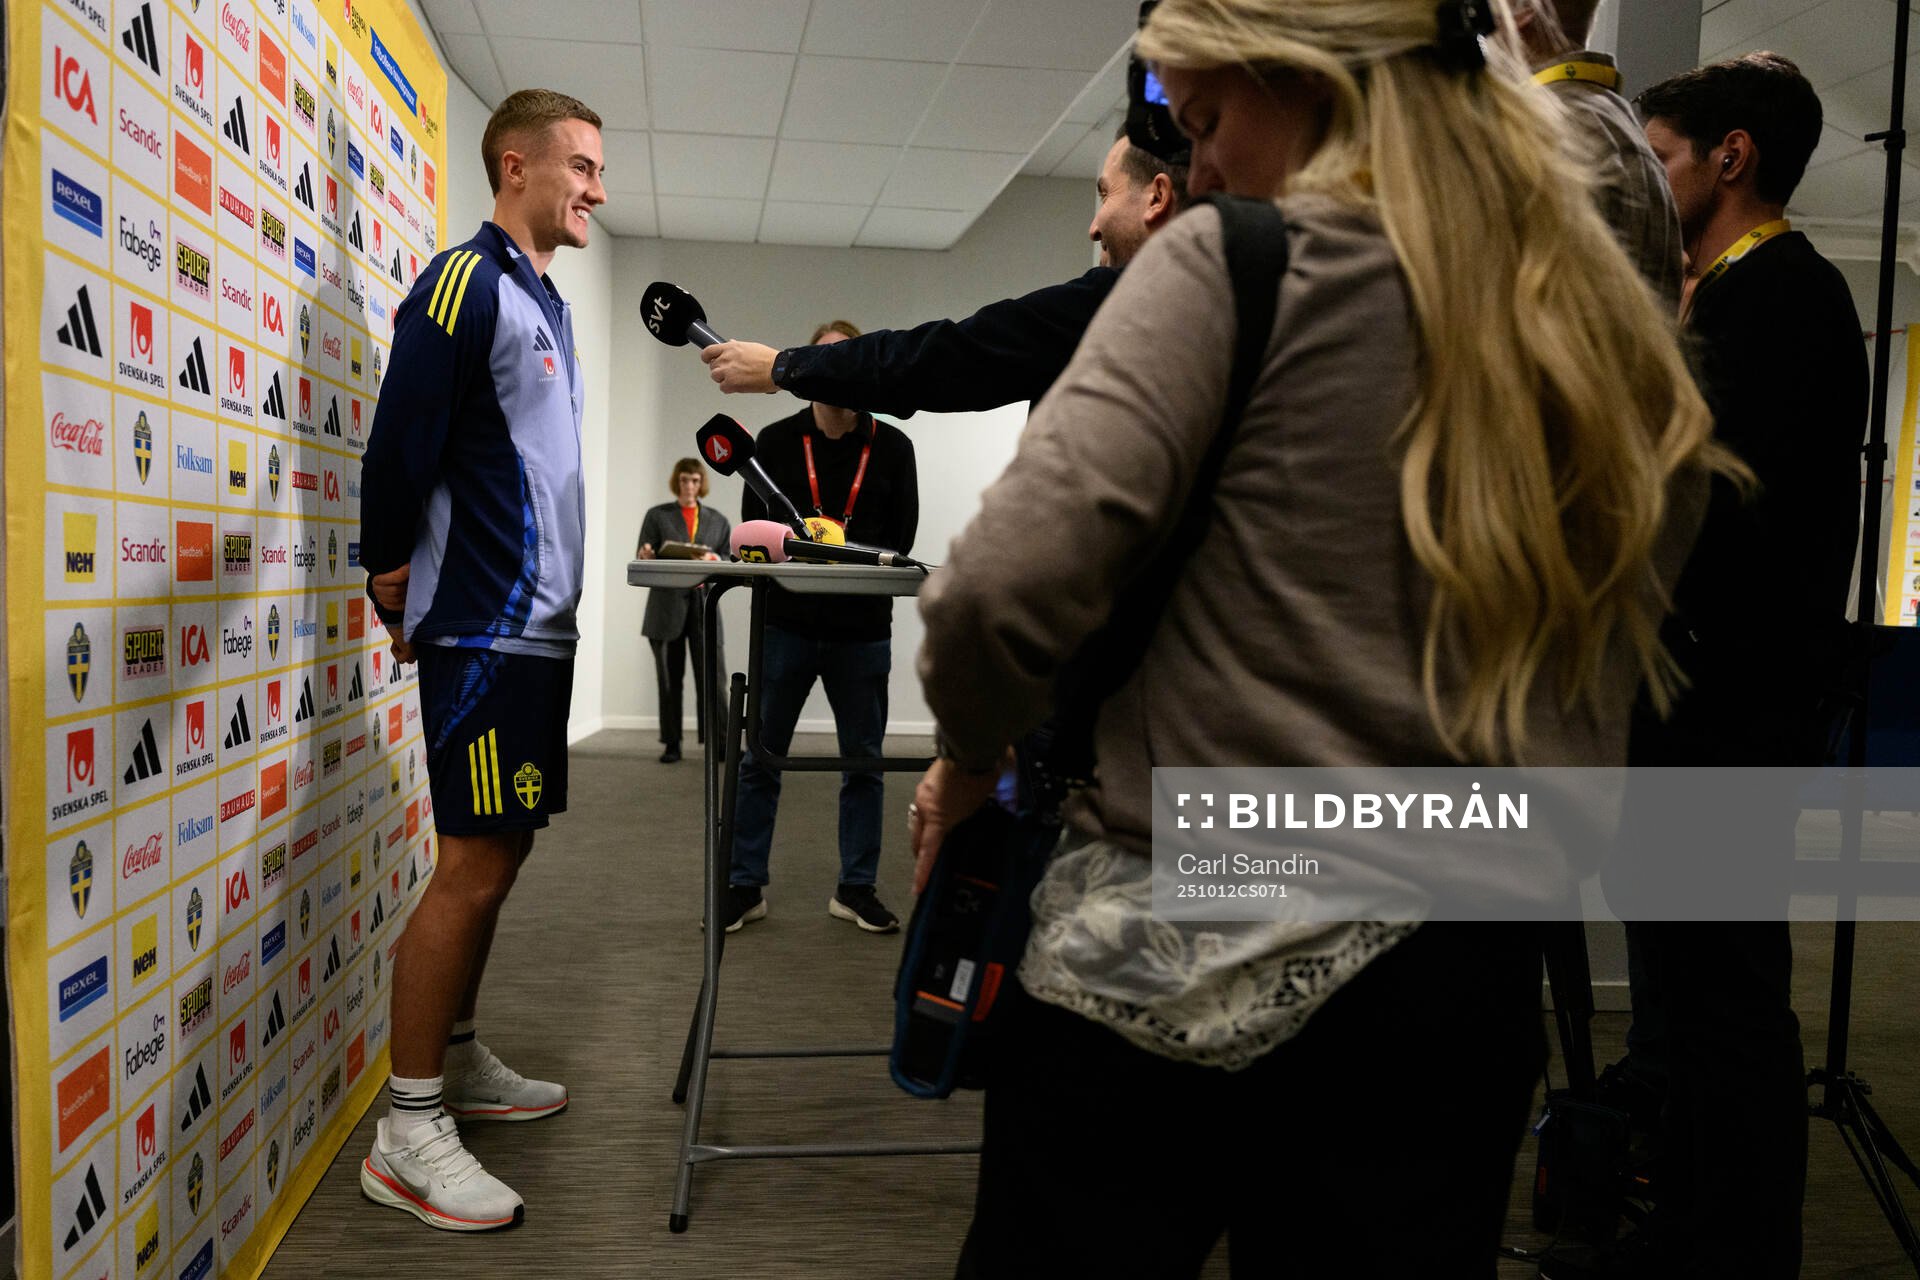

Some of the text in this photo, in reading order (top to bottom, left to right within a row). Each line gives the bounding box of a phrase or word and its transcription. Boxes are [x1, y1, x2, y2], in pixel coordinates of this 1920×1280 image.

[88, 8, 106, 32] SPEL
[54, 44, 97, 126] ICA
[175, 84, 213, 127] SVENSKA SPEL
[371, 99, 383, 141] ICA
[119, 108, 162, 160] Scandic
[260, 159, 278, 184] SVENSKA
[219, 188, 254, 226] BAUHAUS
[120, 215, 161, 272] Fabege
[262, 208, 285, 250] SPORT
[176, 241, 210, 287] SPORT
[178, 274, 210, 298] BLADET
[222, 278, 252, 312] Scandic
[263, 291, 285, 337] ICA
[119, 361, 165, 389] SVENSKA SPEL
[221, 397, 254, 418] SVENSKA SPEL
[50, 412, 104, 457] Coca-Cola
[712, 437, 729, 462] 4
[176, 444, 213, 474] Folksam
[292, 471, 318, 490] BAUHAUS
[324, 469, 340, 502] ICA
[121, 537, 166, 563] Scandic
[224, 535, 251, 563] SPORT
[261, 545, 287, 564] Scandic
[294, 544, 316, 573] Fabege
[225, 563, 251, 572] BLADET
[124, 629, 164, 665] SPORT
[181, 624, 210, 667] ICA
[223, 628, 252, 659] Fabege
[126, 662, 165, 676] BLADET
[176, 753, 214, 776] SVENSKA SPEL
[52, 790, 108, 821] SVENSKA SPEL
[220, 790, 255, 819] BAUHAUS
[177, 815, 213, 847] Folksam
[122, 831, 163, 880] Coca-Cola
[225, 867, 250, 915] ICA
[180, 977, 212, 1027] SPORT
[323, 1006, 340, 1046] ICA
[125, 1032, 165, 1081] Fabege
[124, 1151, 167, 1204] SVENSKA SPEL
[221, 1194, 253, 1241] Scandic
